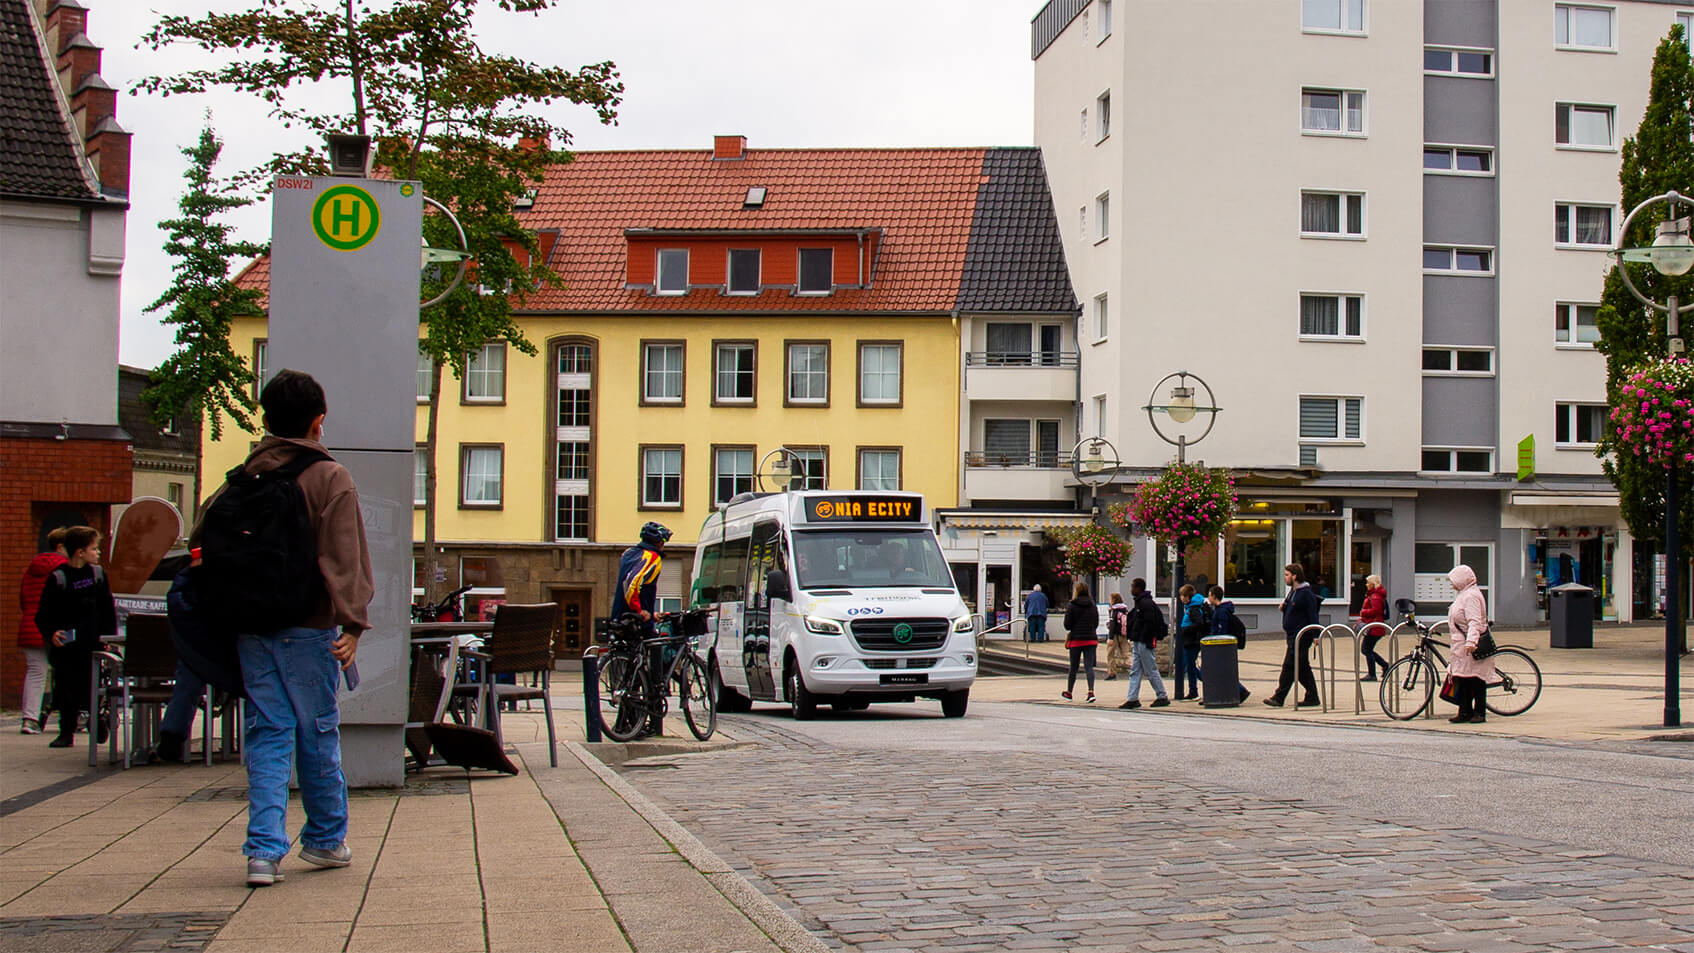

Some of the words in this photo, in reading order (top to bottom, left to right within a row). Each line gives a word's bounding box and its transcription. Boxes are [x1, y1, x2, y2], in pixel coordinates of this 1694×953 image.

[332, 199, 360, 236] H
[835, 502, 862, 516] NIA
[868, 502, 912, 516] ECITY
